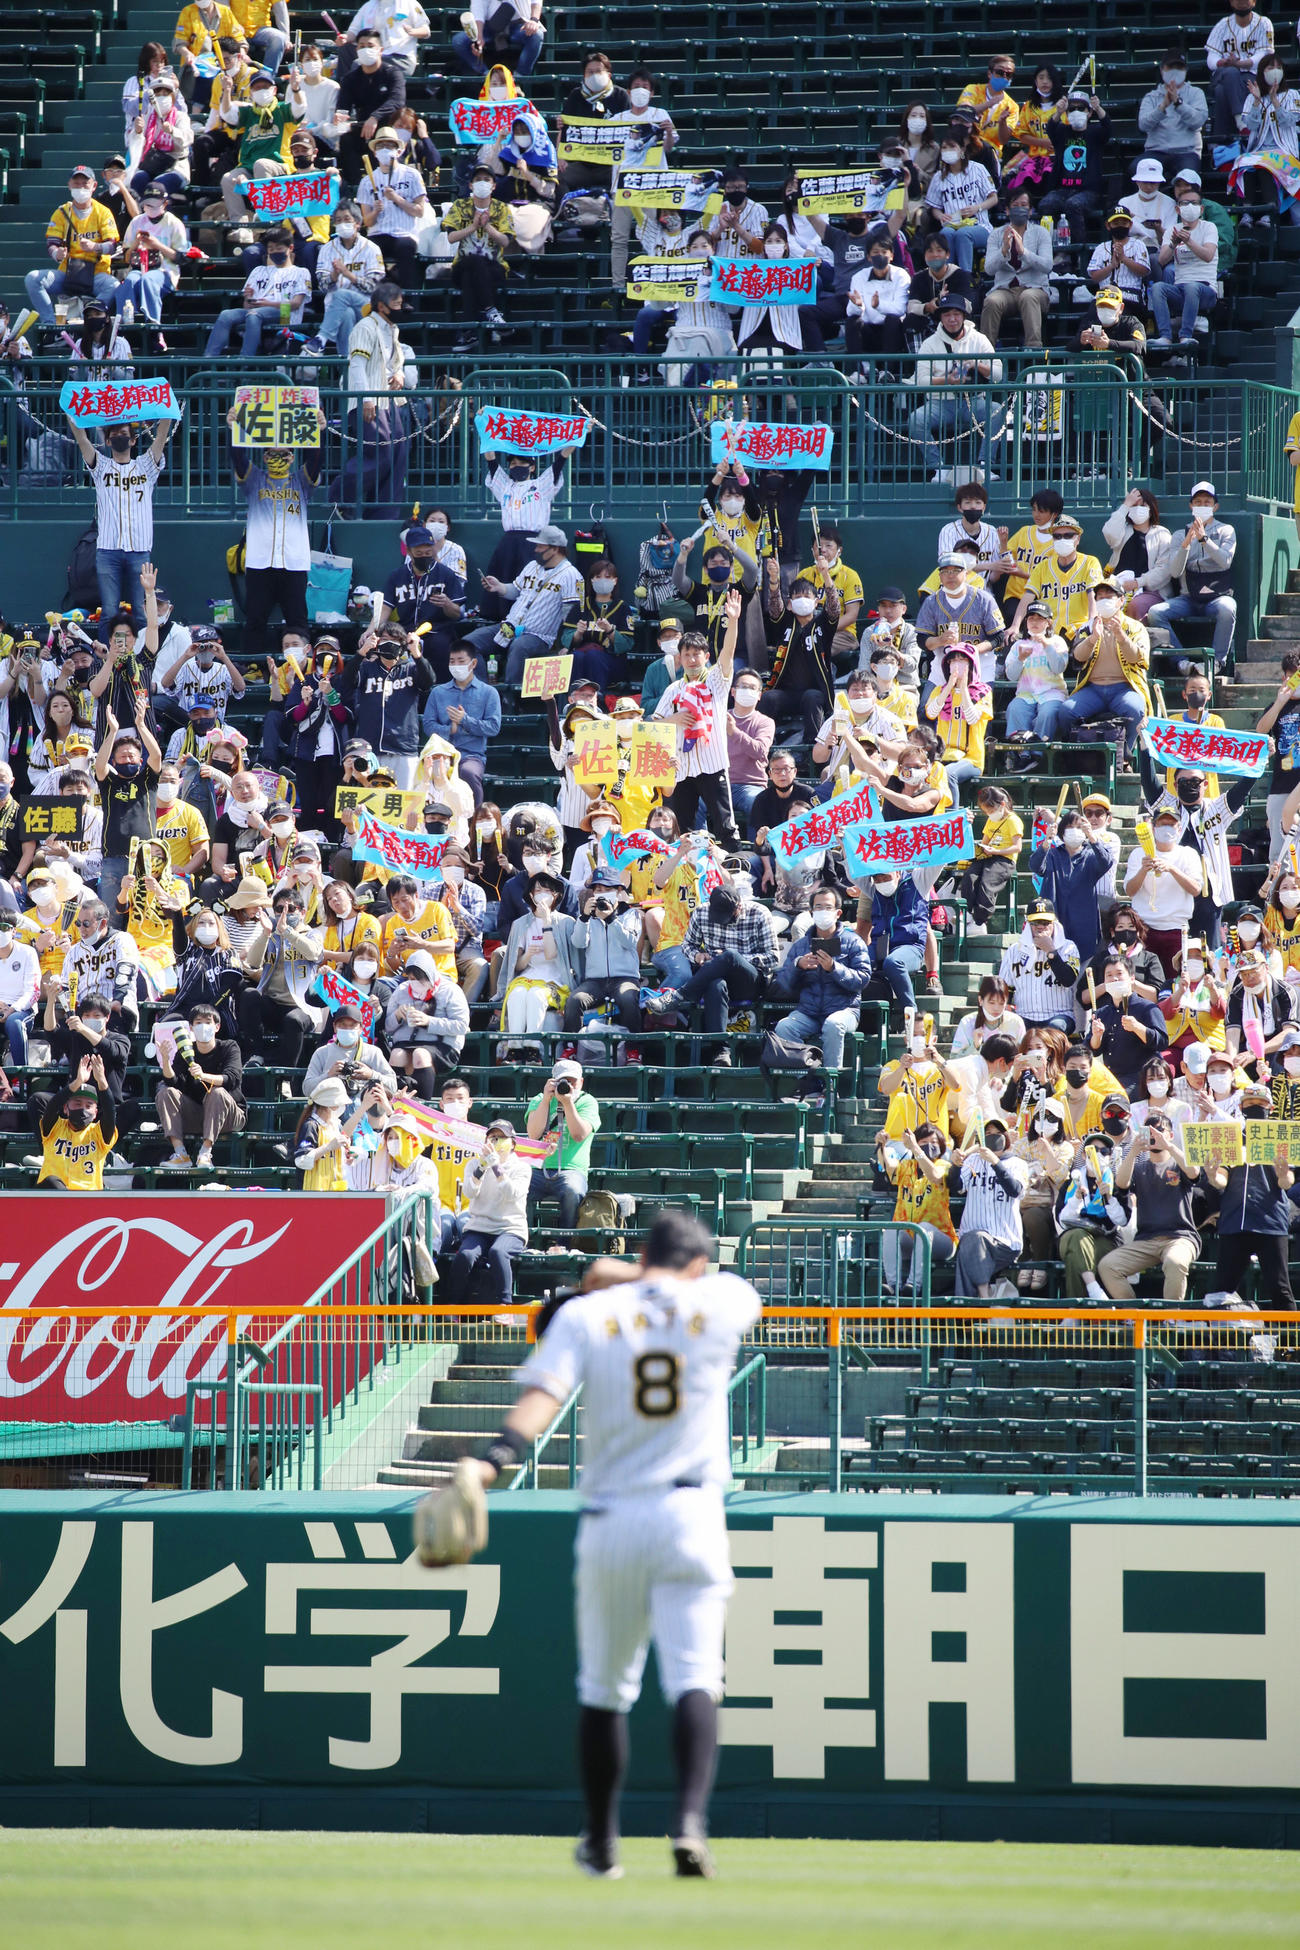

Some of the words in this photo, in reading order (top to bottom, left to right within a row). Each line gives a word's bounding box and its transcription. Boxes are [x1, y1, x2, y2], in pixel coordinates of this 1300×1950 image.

[612, 148, 623, 162] 8
[800, 173, 871, 196] 佐藤輝明
[942, 179, 980, 203] Tigers
[672, 191, 683, 204] 8
[853, 194, 864, 207] 8
[685, 285, 695, 298] 8
[719, 262, 815, 299] 佐藤輝明
[68, 383, 171, 417] 佐藤輝明
[236, 403, 318, 444] 佐藤
[485, 413, 586, 448] 佐藤輝明
[103, 472, 147, 492] Tigers
[135, 490, 144, 502] 7
[502, 492, 540, 510] Tigers
[1041, 580, 1087, 600] Tigers
[365, 676, 414, 697] Tigers
[525, 659, 562, 692] 佐藤
[558, 676, 566, 690] 8
[1151, 725, 1266, 767] 佐藤輝明
[23, 806, 77, 834] 佐藤
[781, 785, 873, 856] 佐藤輝明
[855, 816, 965, 863] 佐藤輝明
[74, 949, 118, 976] Tigers
[105, 967, 115, 980] 3
[1250, 1123, 1300, 1141] 史上最高
[54, 1138, 97, 1162] Tigers
[84, 1161, 95, 1174] 3
[633, 1351, 681, 1418] 8
[0, 1521, 501, 1770] 化学
[717, 1516, 1300, 1788] 朝日
